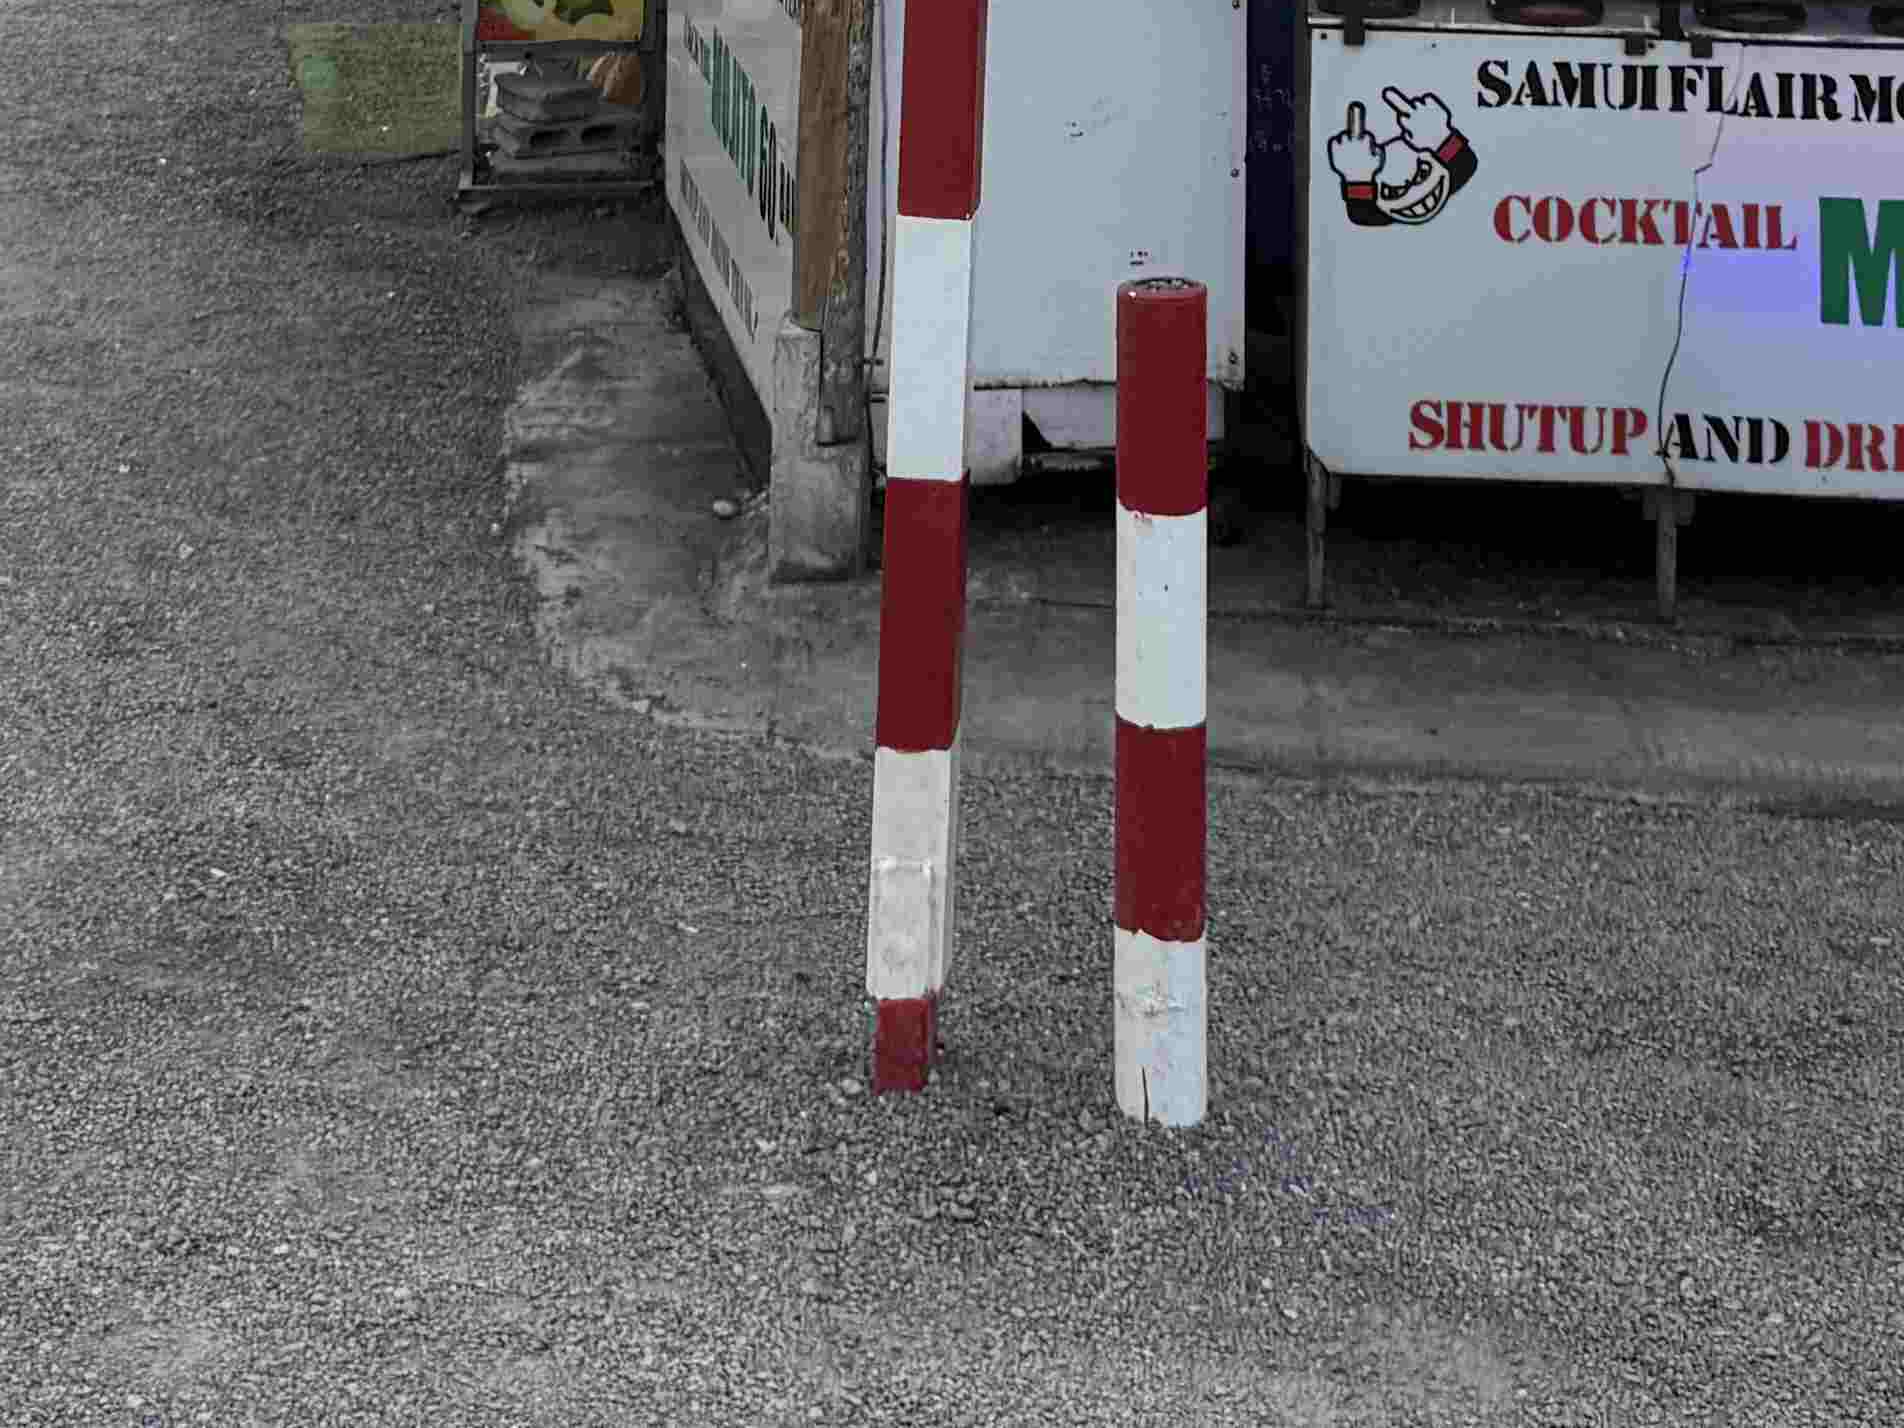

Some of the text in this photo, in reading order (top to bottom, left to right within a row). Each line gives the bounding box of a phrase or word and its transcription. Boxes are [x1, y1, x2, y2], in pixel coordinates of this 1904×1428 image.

[1477, 59, 1660, 112] SAMUI
[1668, 63, 1843, 121] FLAIR
[1494, 194, 1799, 251] COCKTAIL
[1409, 399, 1649, 457] SHUTUP
[1656, 412, 1791, 465] AND
